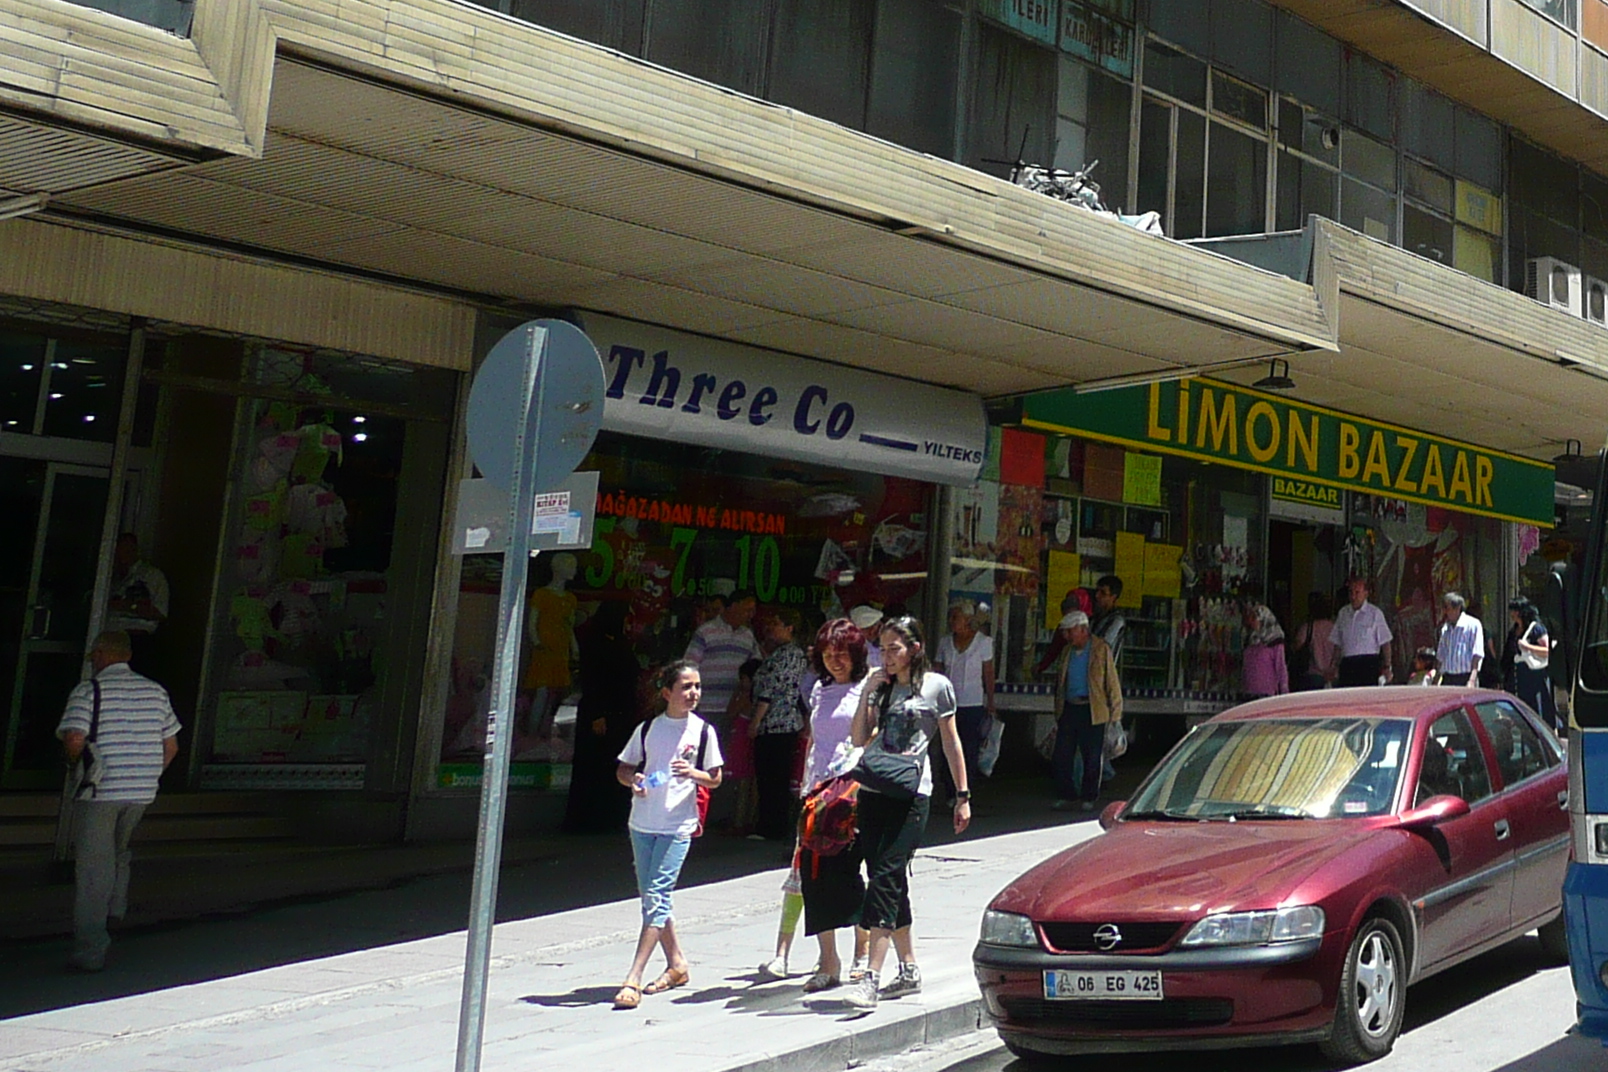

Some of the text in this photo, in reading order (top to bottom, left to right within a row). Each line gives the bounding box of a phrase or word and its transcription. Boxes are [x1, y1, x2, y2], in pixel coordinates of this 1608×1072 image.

[605, 344, 854, 441] Three Co
[923, 441, 982, 464] YILTEKS
[1338, 421, 1494, 508] BAZAAR
[1274, 478, 1339, 504] BAZAAR
[1078, 975, 1160, 992] 06 EG 425
